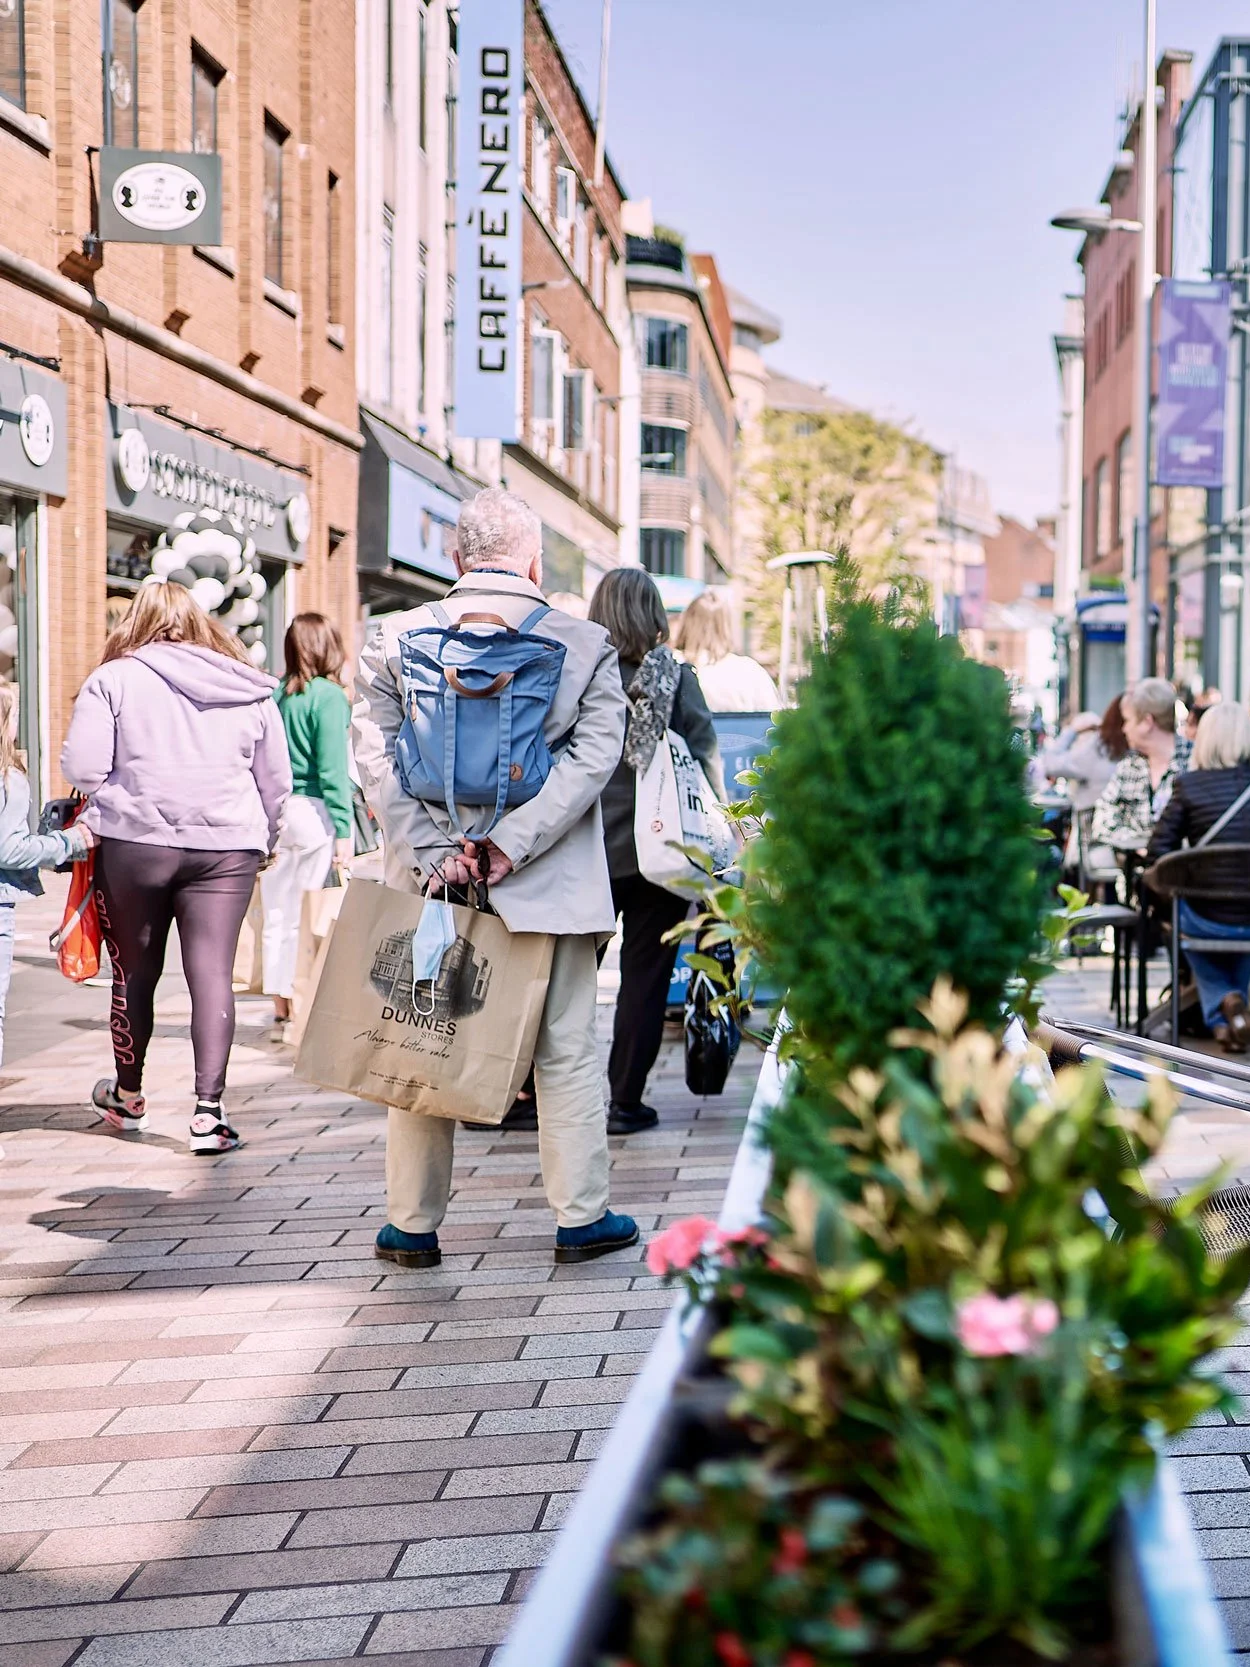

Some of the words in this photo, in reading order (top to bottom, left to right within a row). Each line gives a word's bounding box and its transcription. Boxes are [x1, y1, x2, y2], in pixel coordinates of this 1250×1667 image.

[480, 47, 510, 194] NERO
[381, 1006, 457, 1036] DUNNES
[353, 1028, 395, 1050] Always
[399, 1037, 426, 1053] better
[429, 1046, 451, 1060] value
[420, 1031, 455, 1046] STORES
